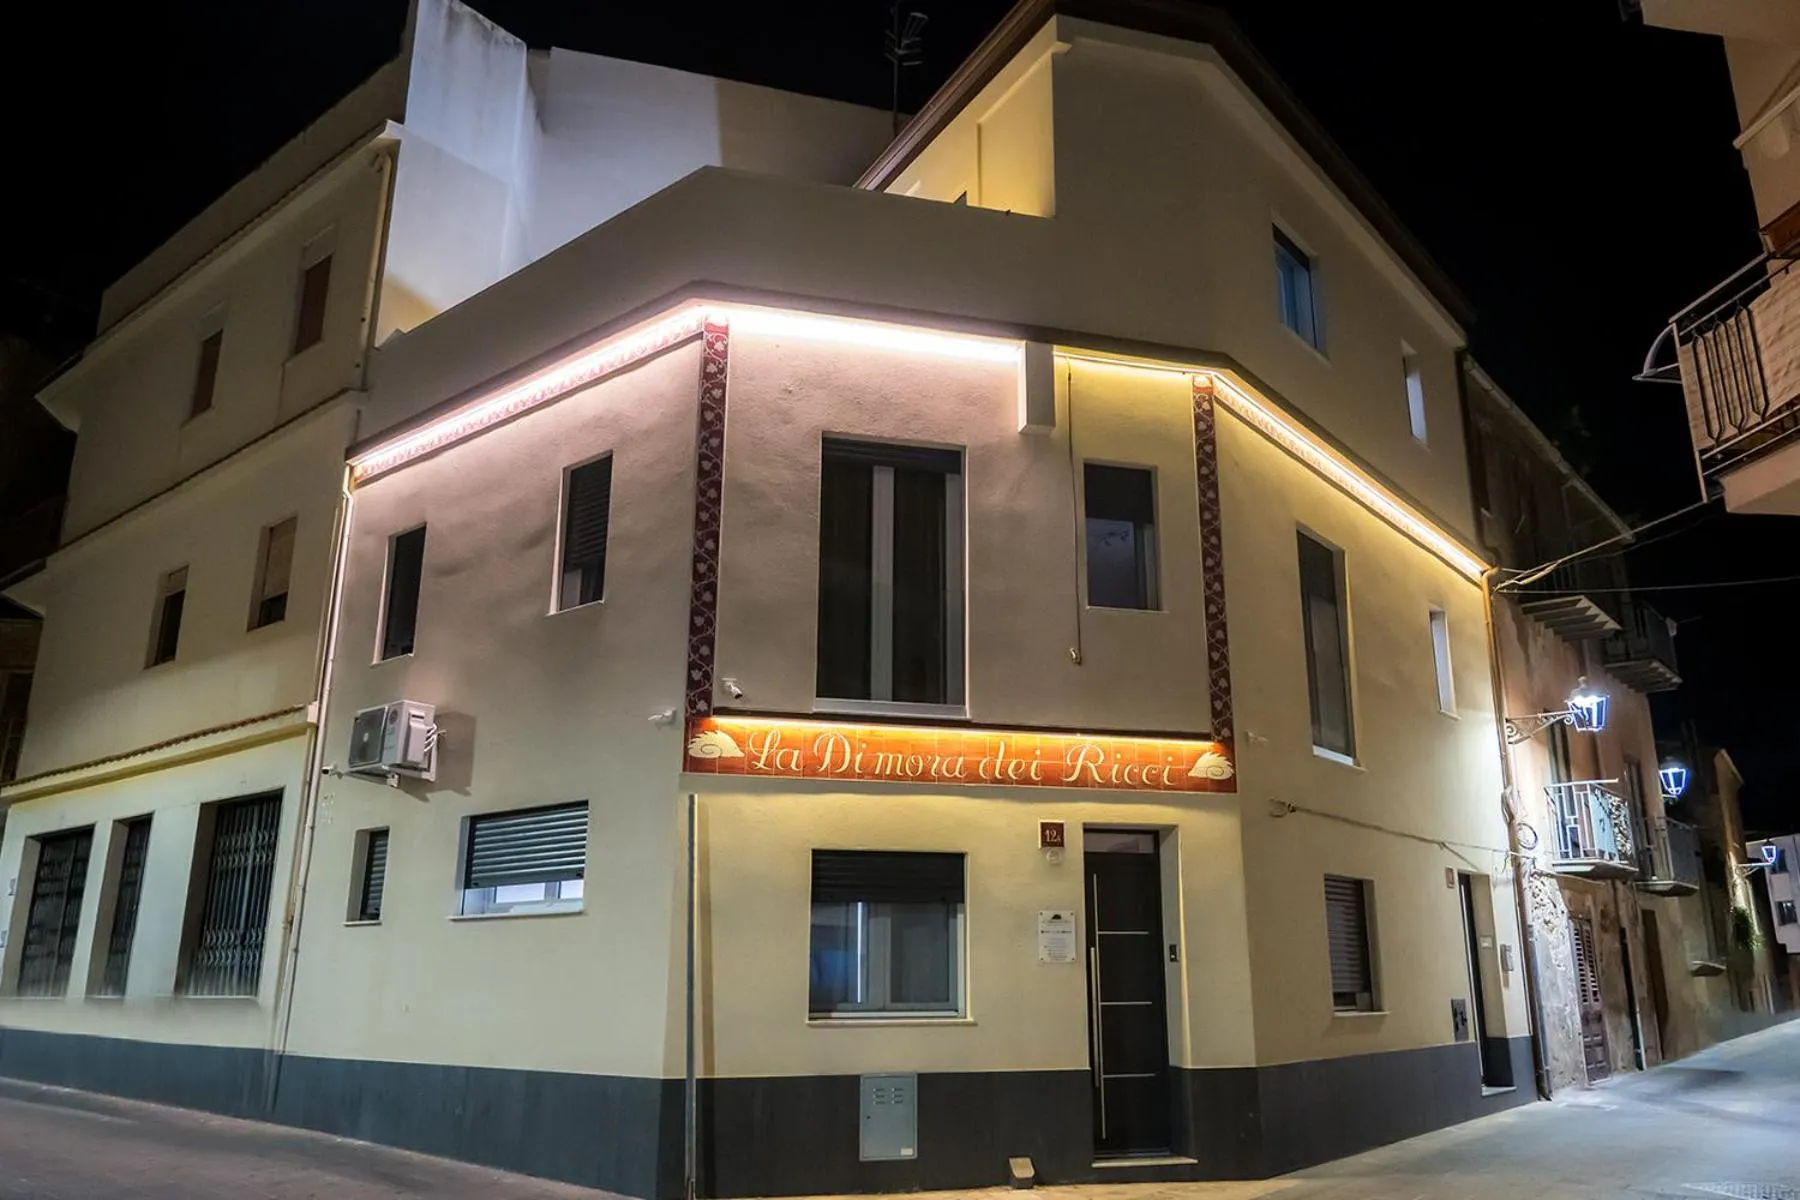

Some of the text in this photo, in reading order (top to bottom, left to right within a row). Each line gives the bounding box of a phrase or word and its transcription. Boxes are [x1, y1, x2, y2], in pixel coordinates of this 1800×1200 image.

[749, 729, 802, 771] La
[978, 740, 1041, 781] dei
[1063, 744, 1174, 786] Ricci
